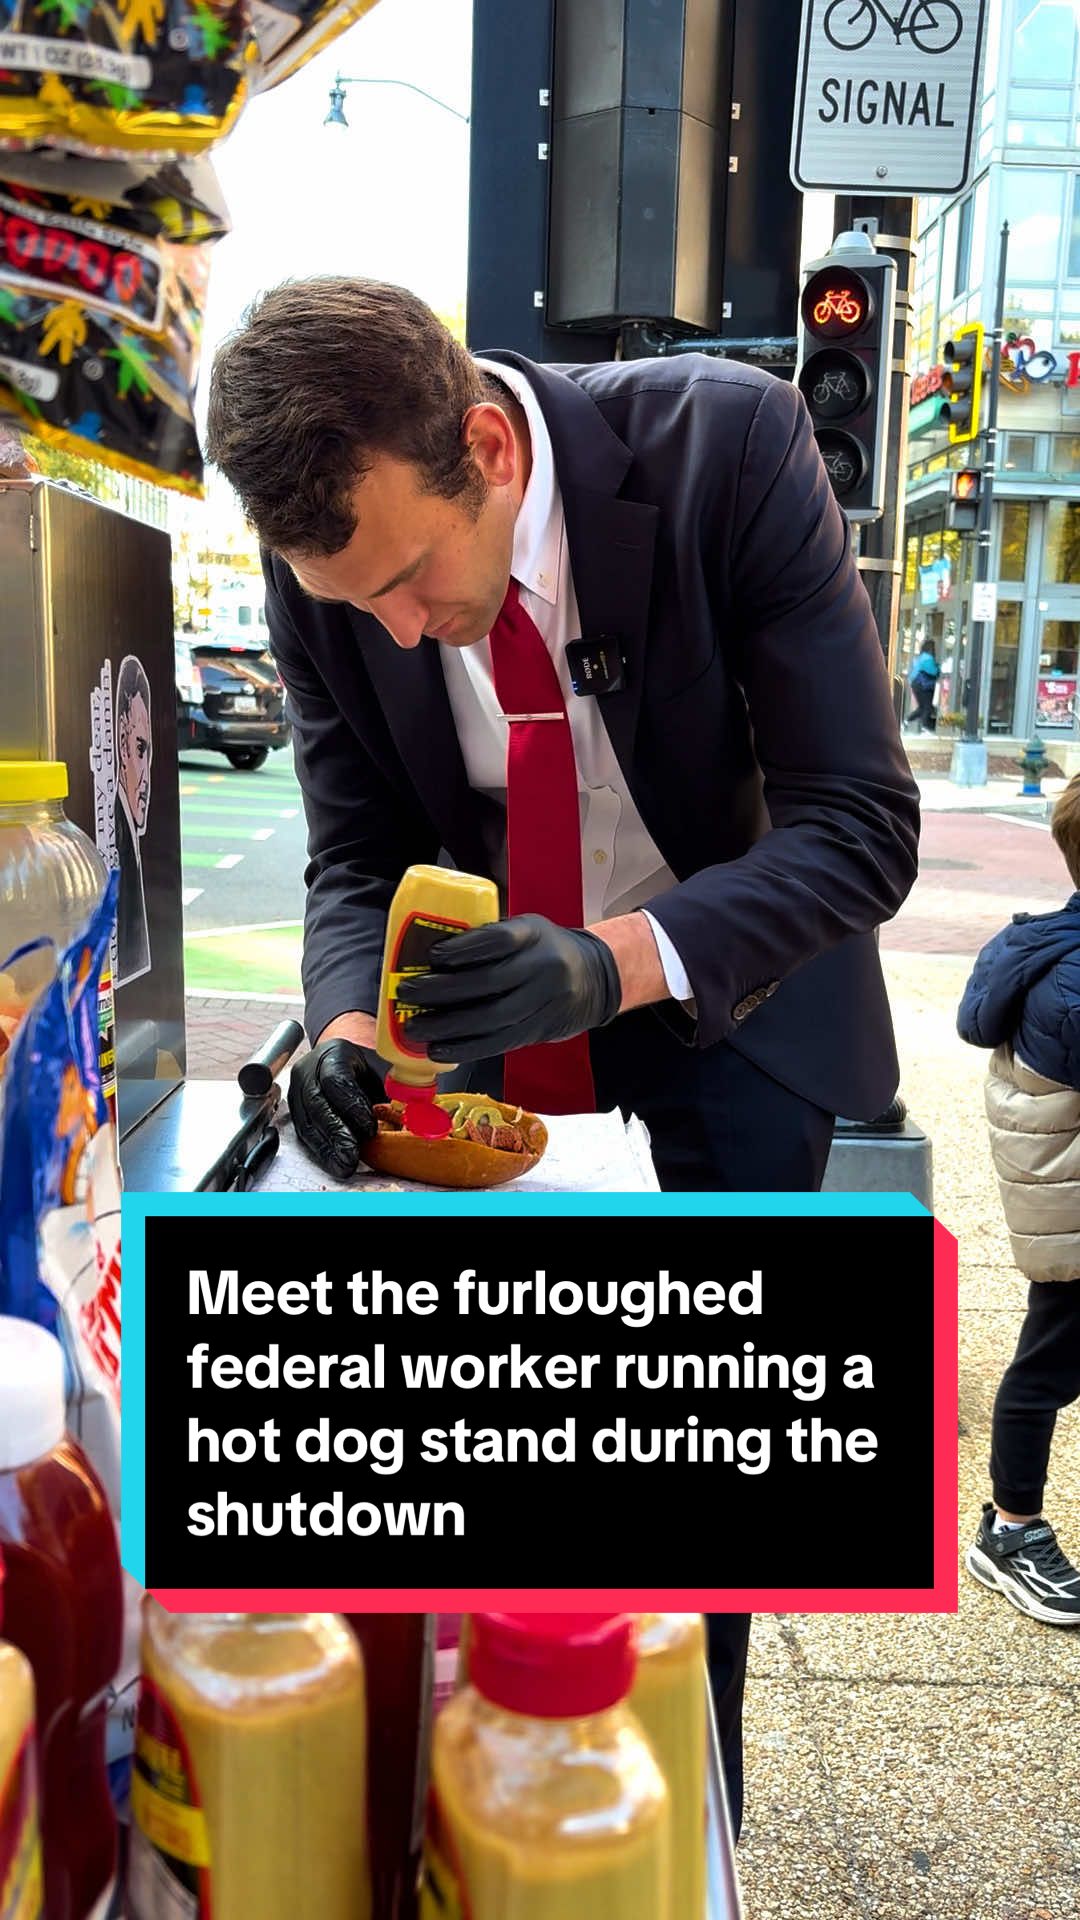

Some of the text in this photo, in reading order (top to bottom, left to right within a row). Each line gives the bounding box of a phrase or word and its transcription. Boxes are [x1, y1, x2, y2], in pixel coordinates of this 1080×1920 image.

[818, 78, 955, 127] SIGNAL
[97, 786, 107, 832] my
[107, 779, 114, 793] a
